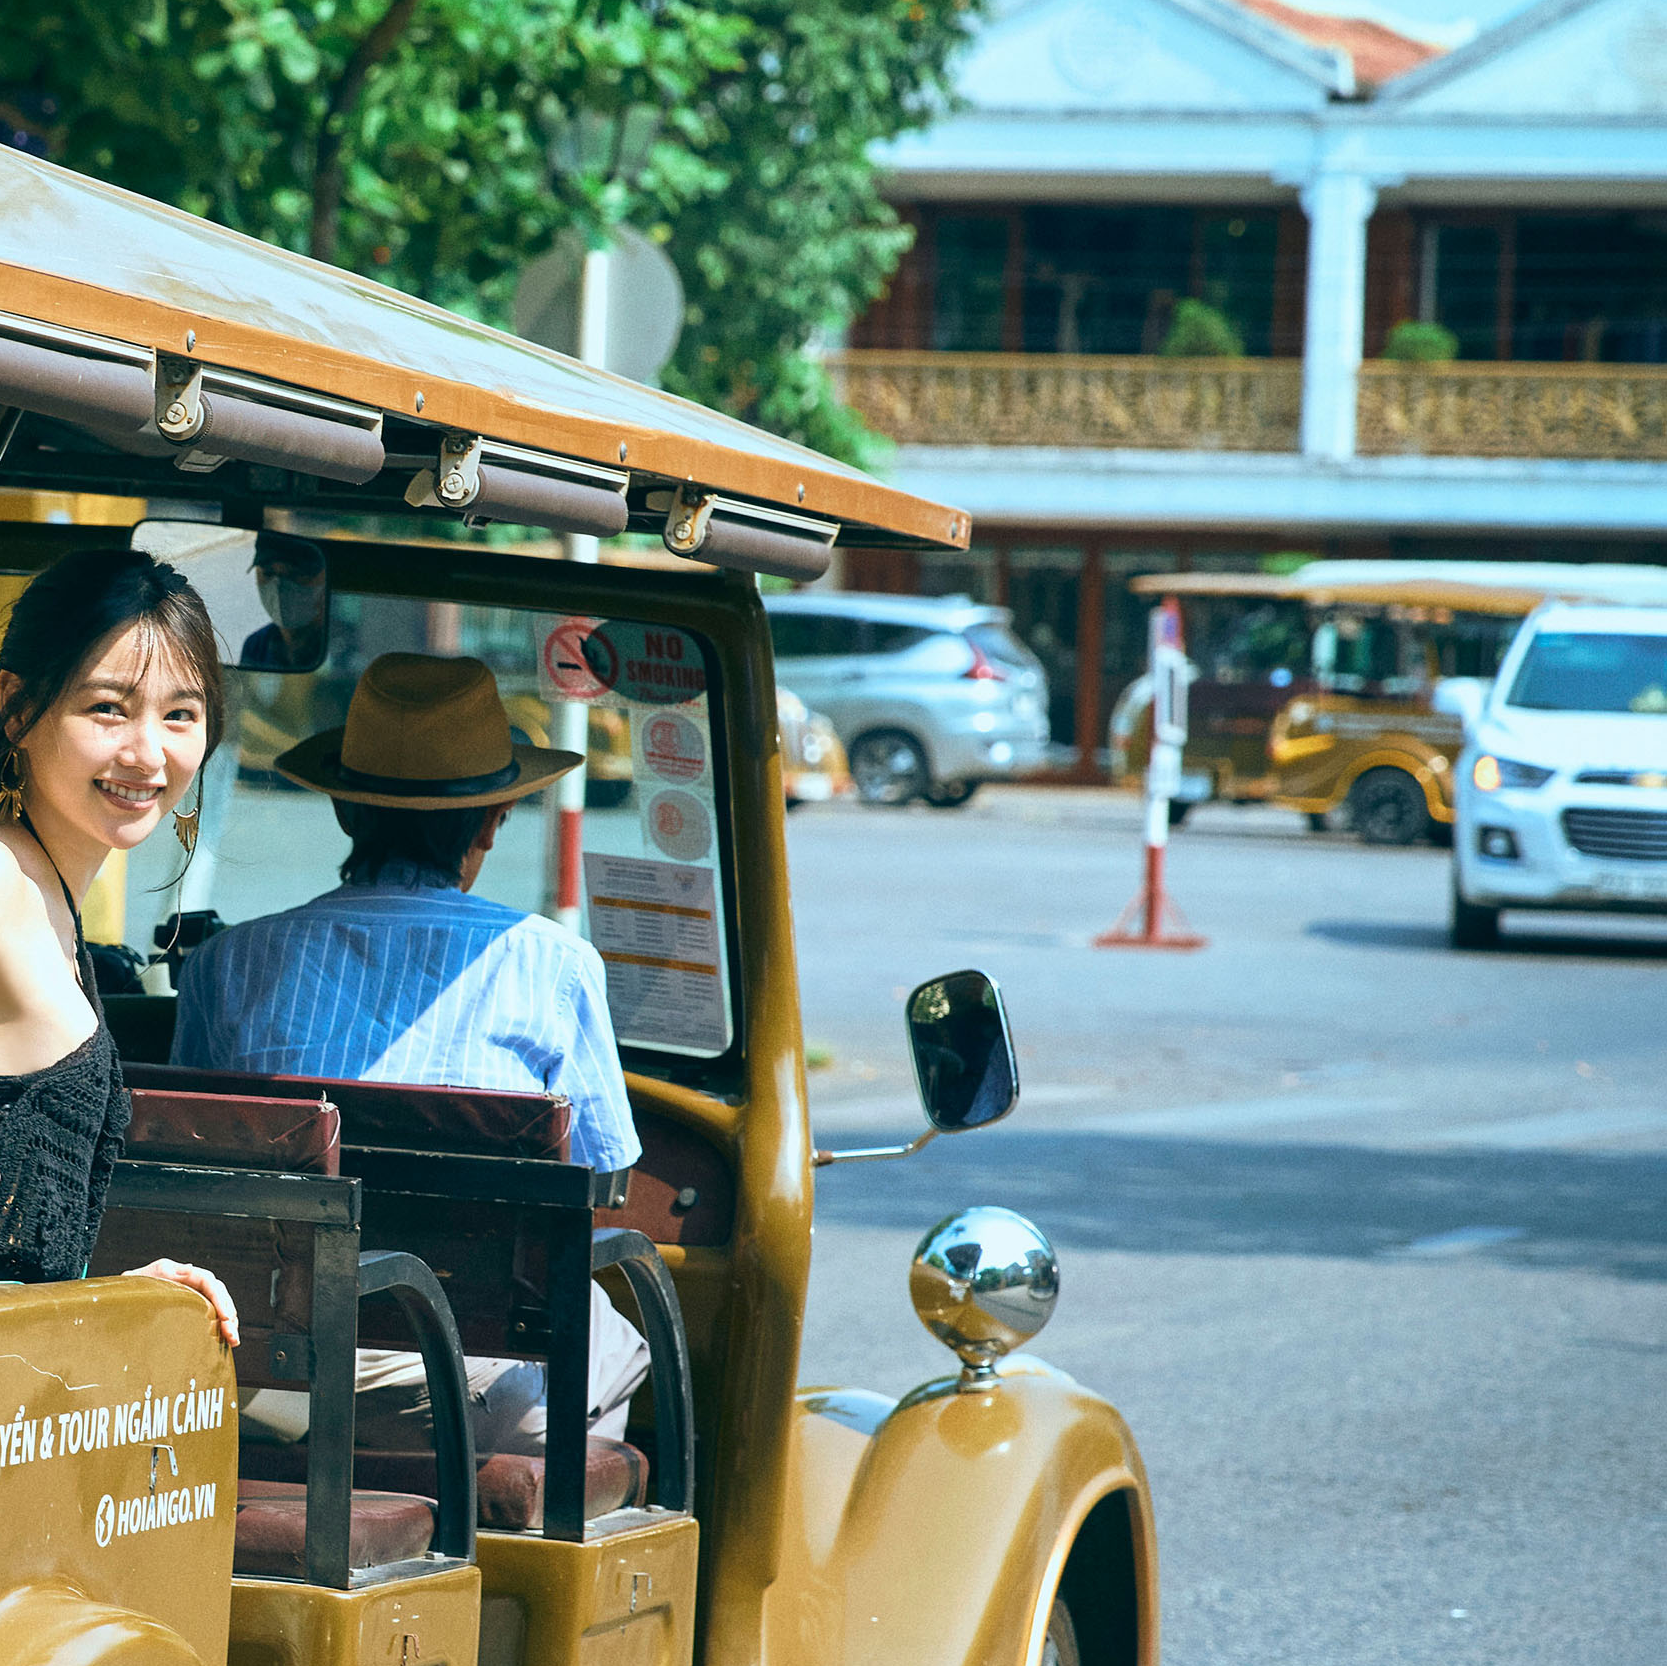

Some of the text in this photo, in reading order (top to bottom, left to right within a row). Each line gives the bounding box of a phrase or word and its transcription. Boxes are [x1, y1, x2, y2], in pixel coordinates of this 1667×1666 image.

[644, 632, 683, 661] NO
[626, 660, 706, 690] SMOKING
[39, 1416, 55, 1460] &
[58, 1406, 110, 1457] TOUR
[113, 1384, 169, 1446] NGẮM
[172, 1378, 225, 1435] CẢNH
[116, 1483, 216, 1537] HOIANGO.VN
